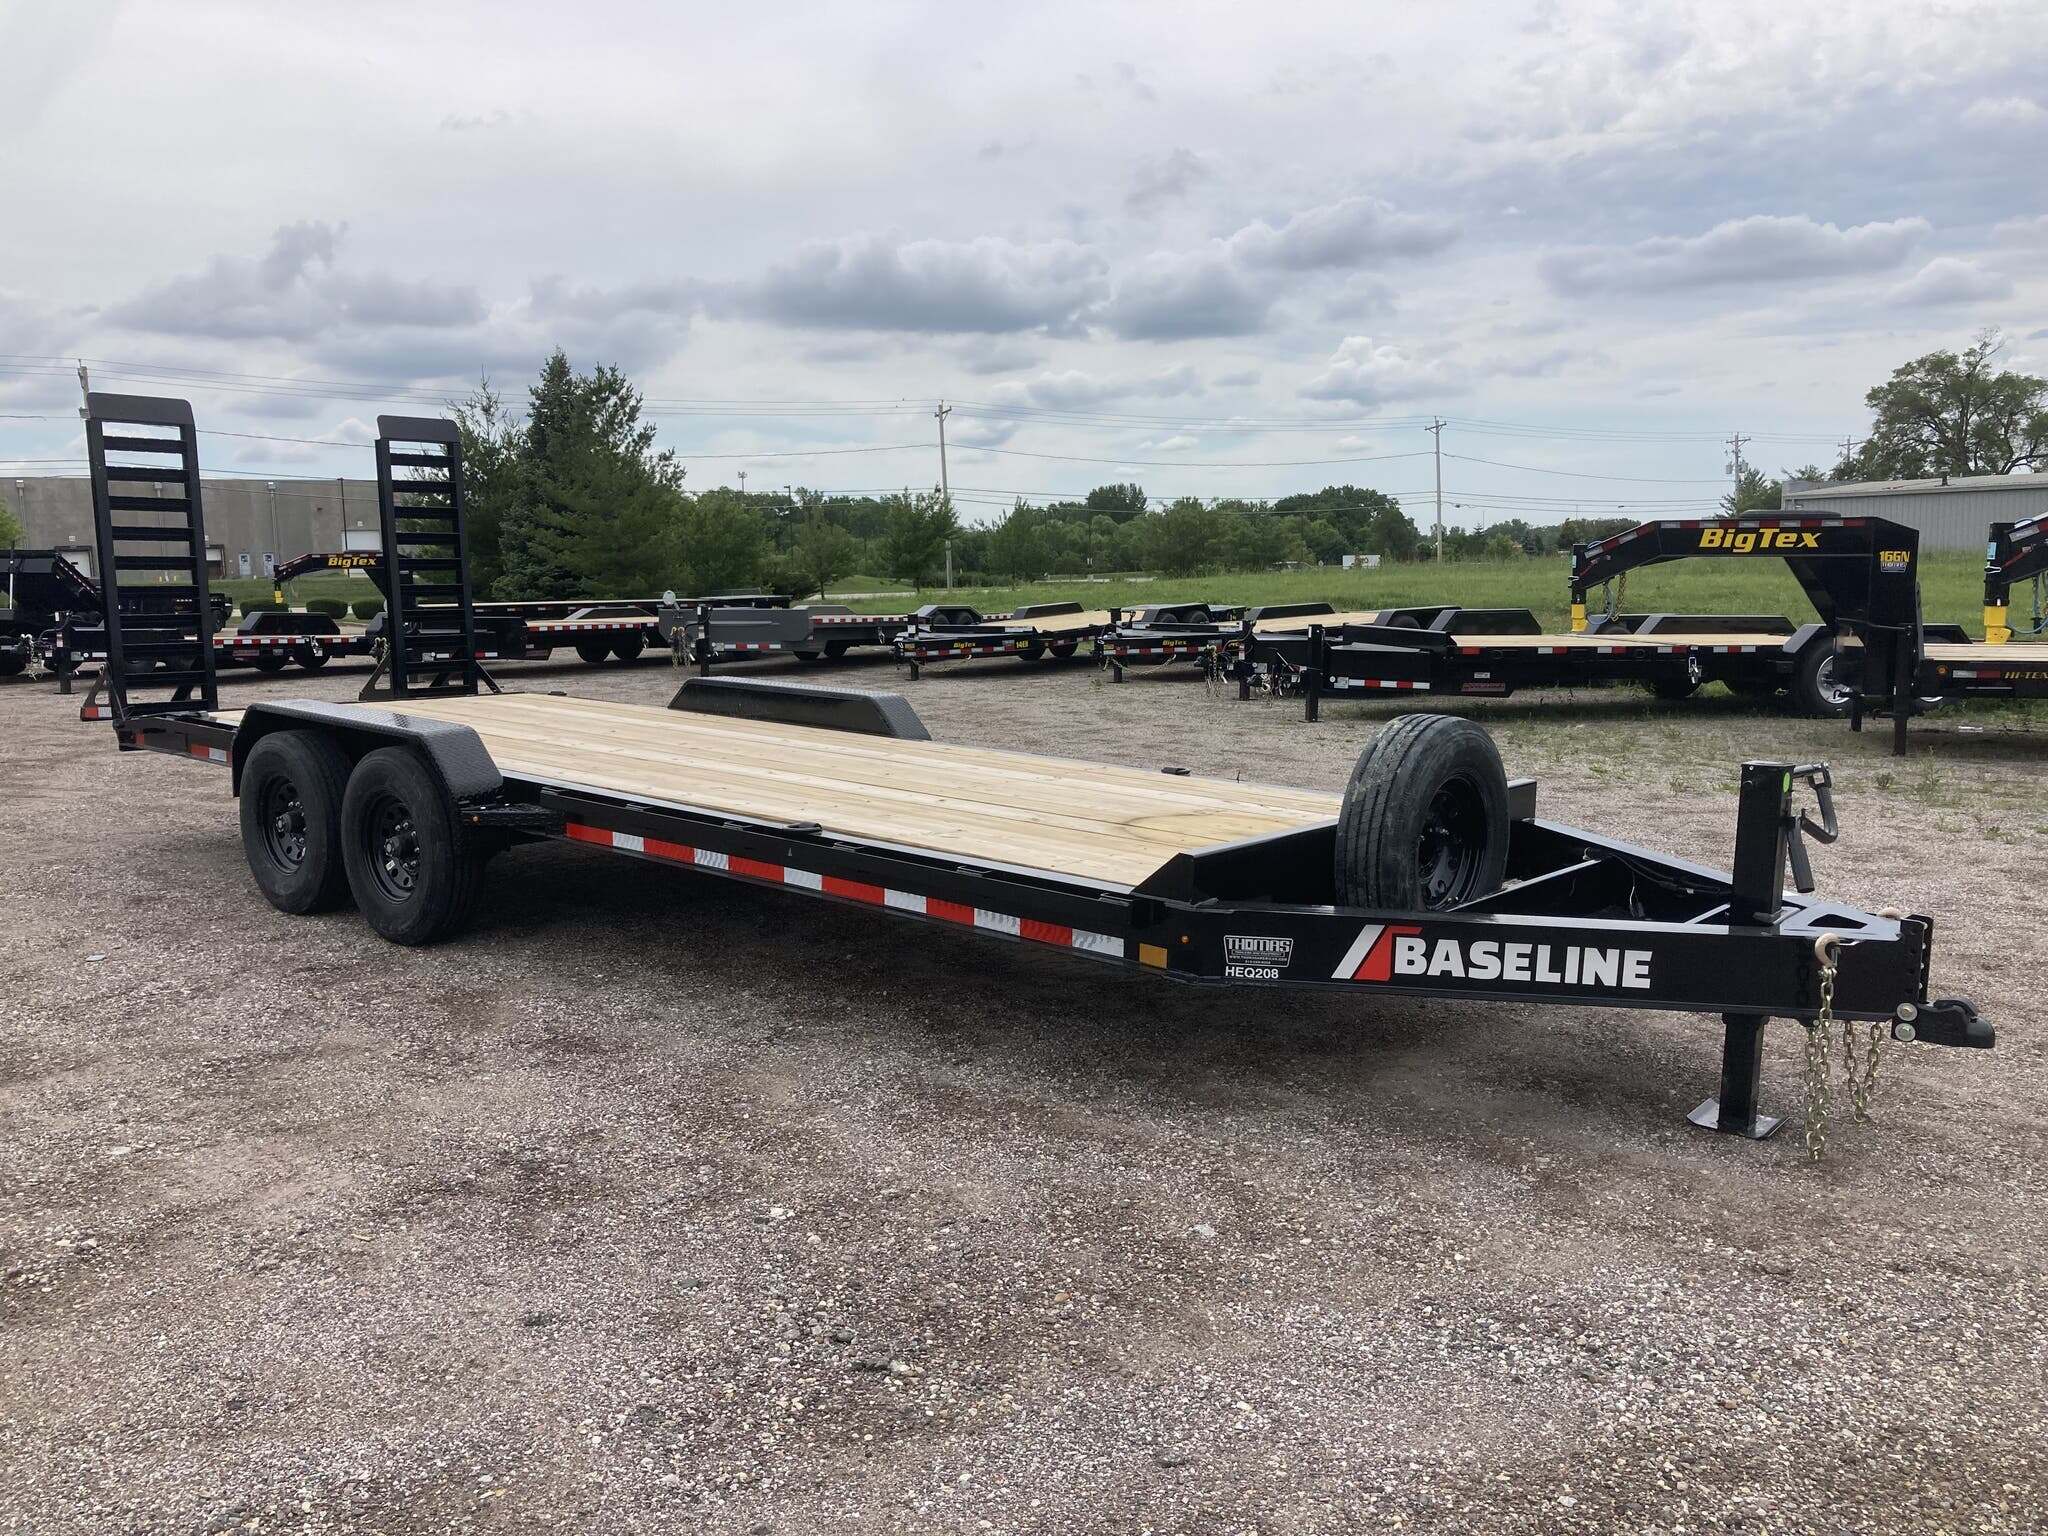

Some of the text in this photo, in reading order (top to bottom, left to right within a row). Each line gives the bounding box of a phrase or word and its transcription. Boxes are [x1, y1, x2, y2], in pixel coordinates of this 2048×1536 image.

[1699, 528, 1822, 552] BigTex
[328, 557, 376, 567] BigTex
[1226, 938, 1290, 952] THOMAS
[1394, 936, 1653, 989] BASELINE
[1225, 965, 1279, 979] HEQ208
